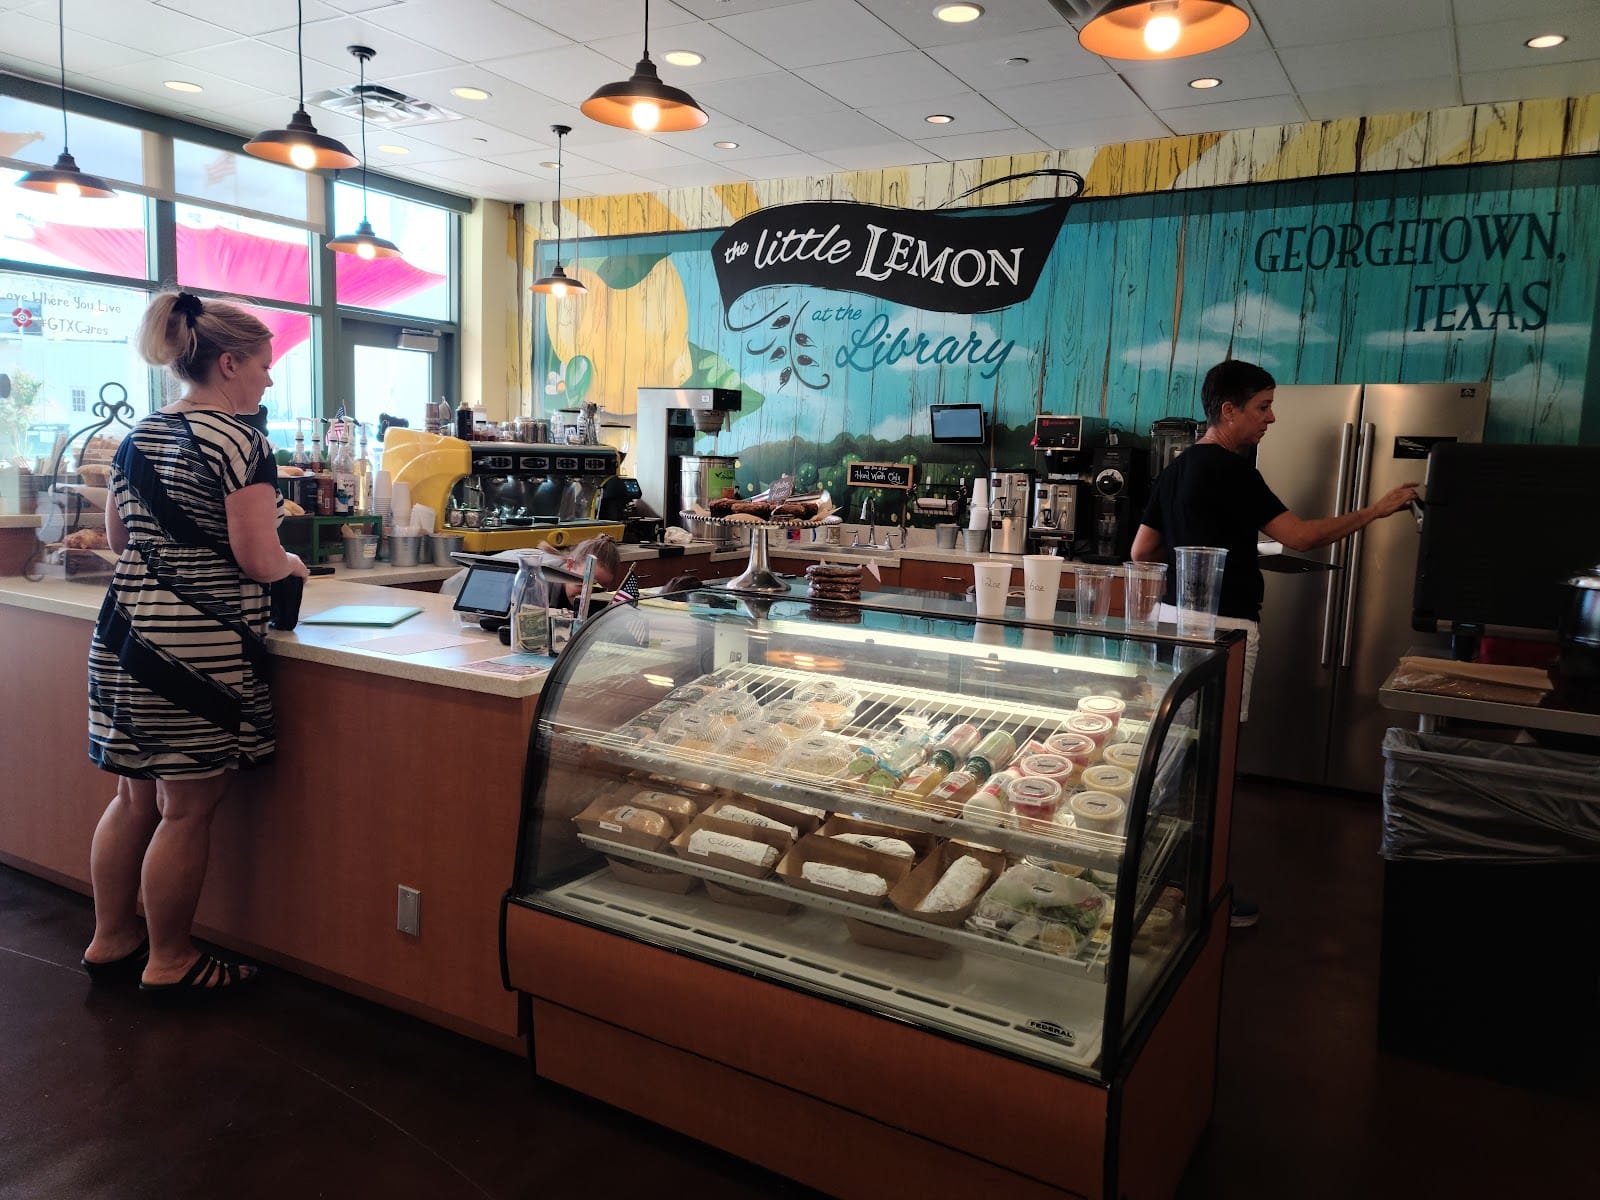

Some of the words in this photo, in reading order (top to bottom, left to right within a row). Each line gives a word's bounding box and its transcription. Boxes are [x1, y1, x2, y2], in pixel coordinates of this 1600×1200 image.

[1254, 211, 1566, 273] GEORGETOWN,
[724, 240, 749, 265] the
[754, 223, 852, 270] little
[855, 223, 1025, 288] LEMON
[32, 291, 70, 307] Where
[73, 296, 94, 310] You
[97, 299, 121, 314] Live
[811, 306, 834, 322] at
[835, 305, 862, 321] the
[1413, 280, 1551, 333] TEXAS
[40, 317, 109, 336] #GTXCares
[835, 313, 1016, 380] Library
[854, 470, 870, 481] Hand
[871, 470, 886, 481] Wash
[1030, 1021, 1073, 1039] FEDERAL
